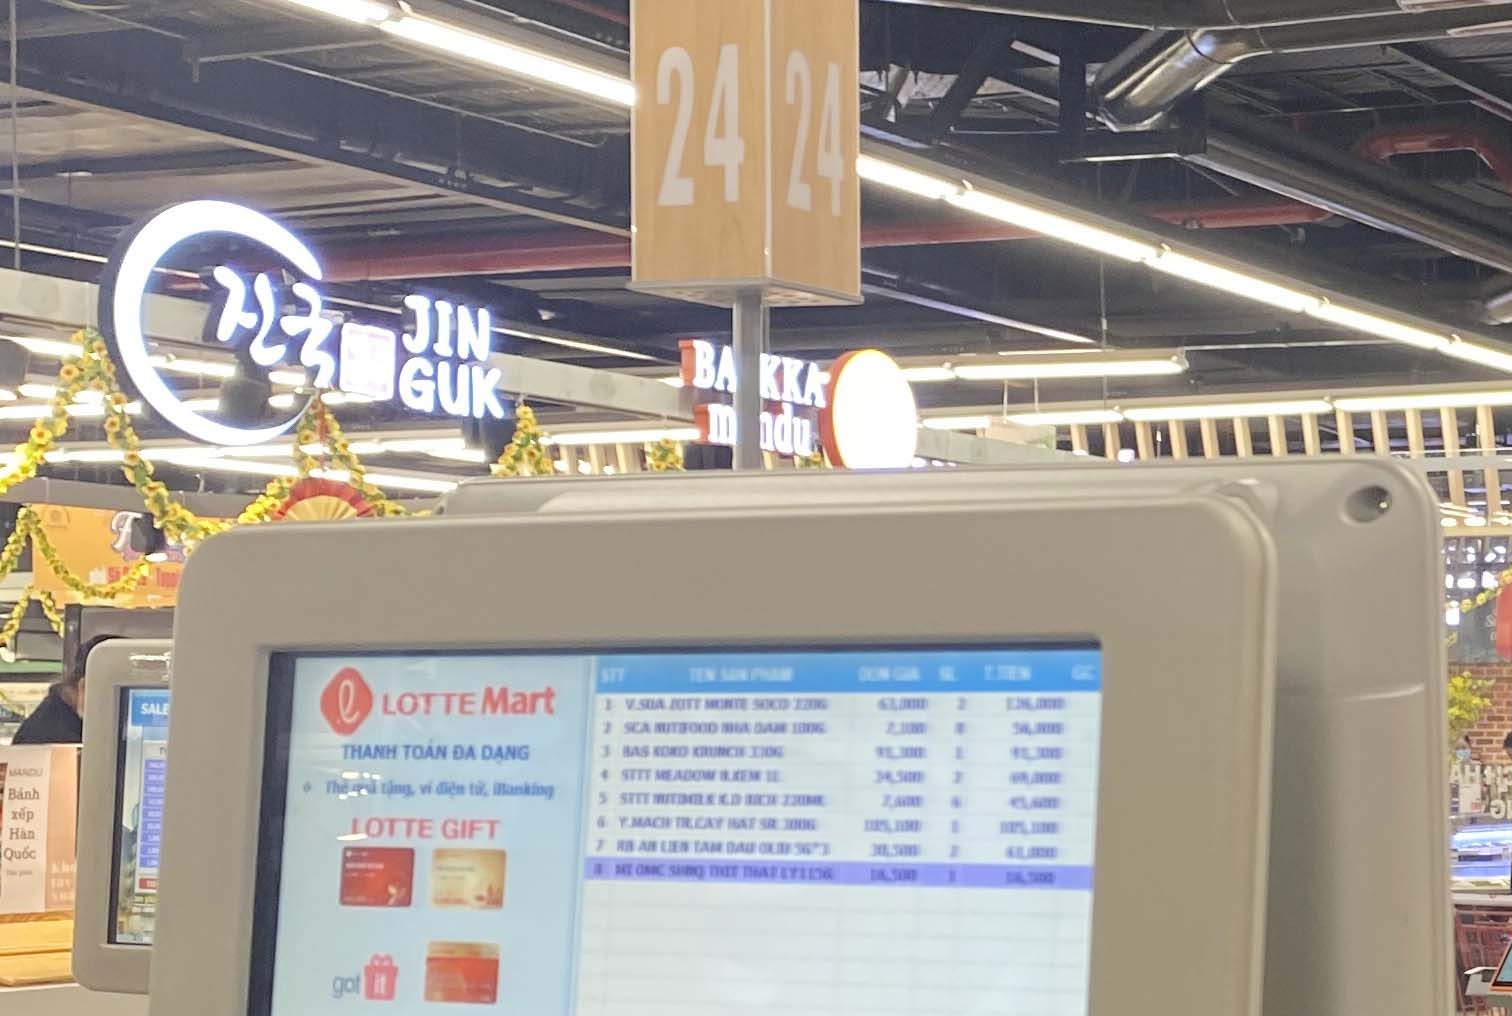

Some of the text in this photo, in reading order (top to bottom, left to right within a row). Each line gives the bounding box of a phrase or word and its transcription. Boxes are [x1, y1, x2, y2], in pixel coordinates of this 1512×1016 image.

[657, 44, 745, 206] 24
[785, 49, 845, 217] 24
[402, 294, 491, 362] JIN
[399, 356, 505, 420] GUK
[707, 402, 812, 457] mndu
[381, 685, 557, 717] LOTTE Mart
[342, 738, 531, 765] THANH TOÁN ĐA DẠNG
[8, 786, 41, 803] Bánh
[10, 806, 35, 824] xếp
[350, 817, 501, 840] LOTTE GIFT
[8, 827, 36, 842] Hàn
[3, 844, 37, 862] Quốc
[332, 972, 361, 1000] got
